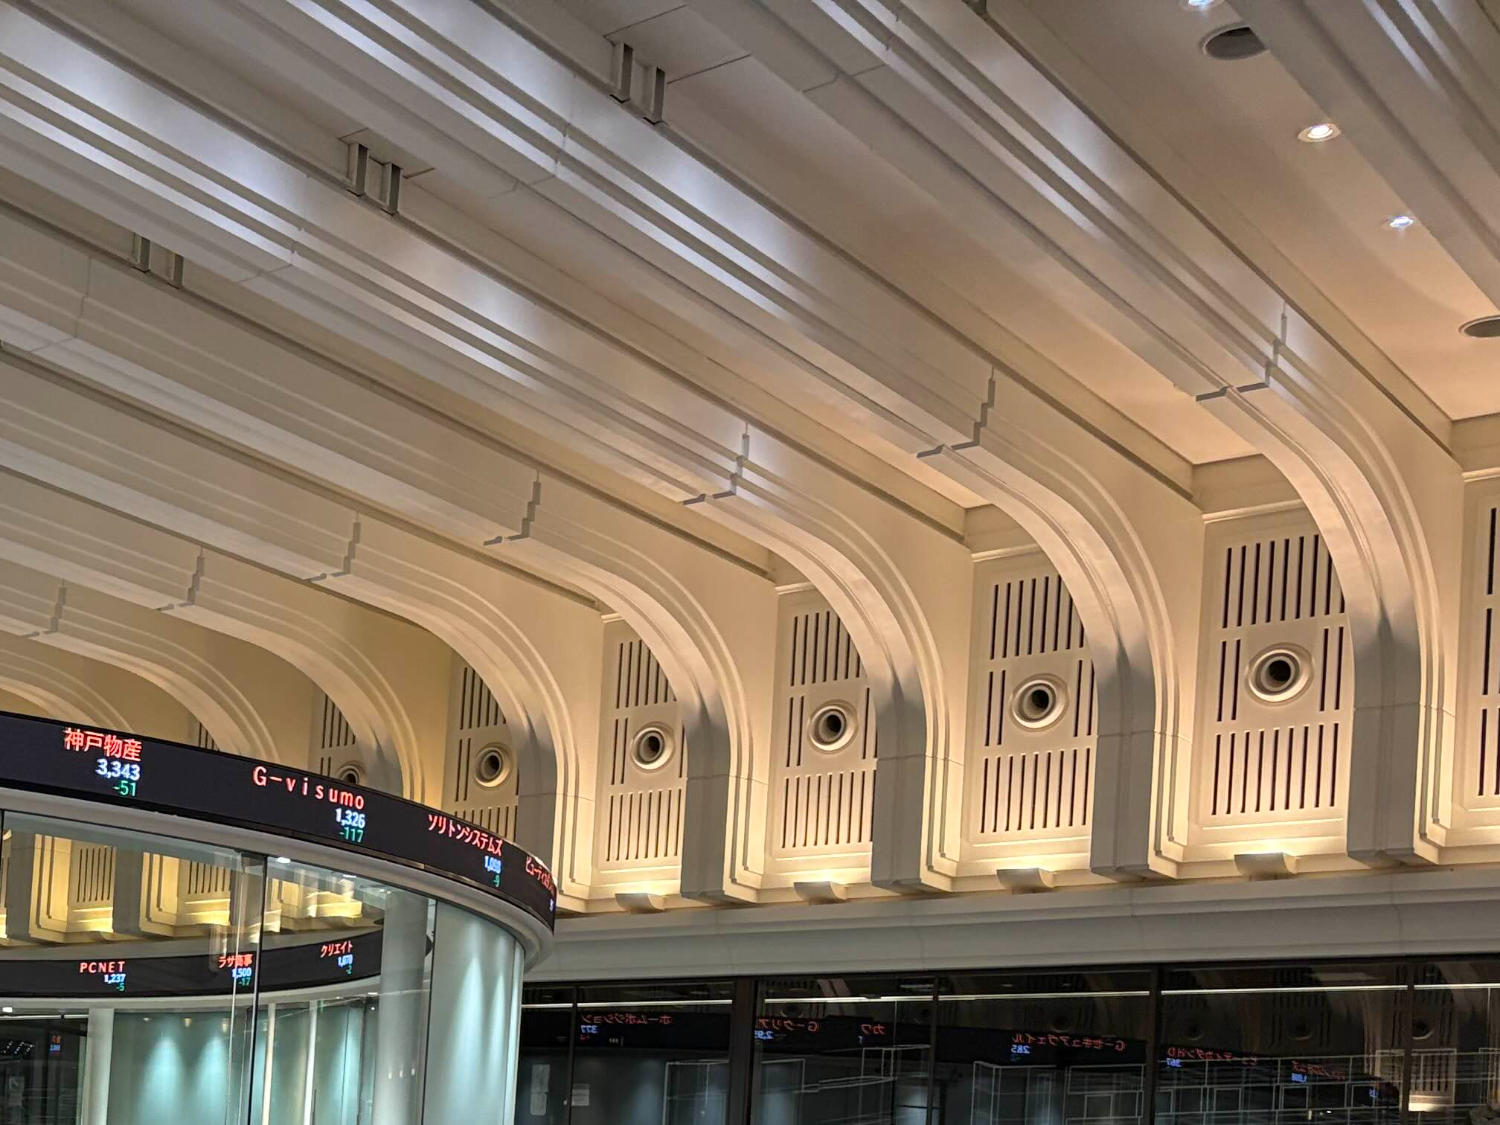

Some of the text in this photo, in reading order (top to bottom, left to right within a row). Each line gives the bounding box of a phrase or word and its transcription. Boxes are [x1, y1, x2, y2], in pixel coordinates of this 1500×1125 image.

[63, 727, 142, 763] 神戸物産
[95, 758, 140, 781] 3,343
[112, 781, 137, 798] -51
[334, 808, 366, 830] 1,326
[338, 829, 364, 844] -117
[428, 813, 503, 857] ソリトンシステムズ
[320, 940, 353, 958] クリエイト
[79, 961, 126, 974] PCNET
